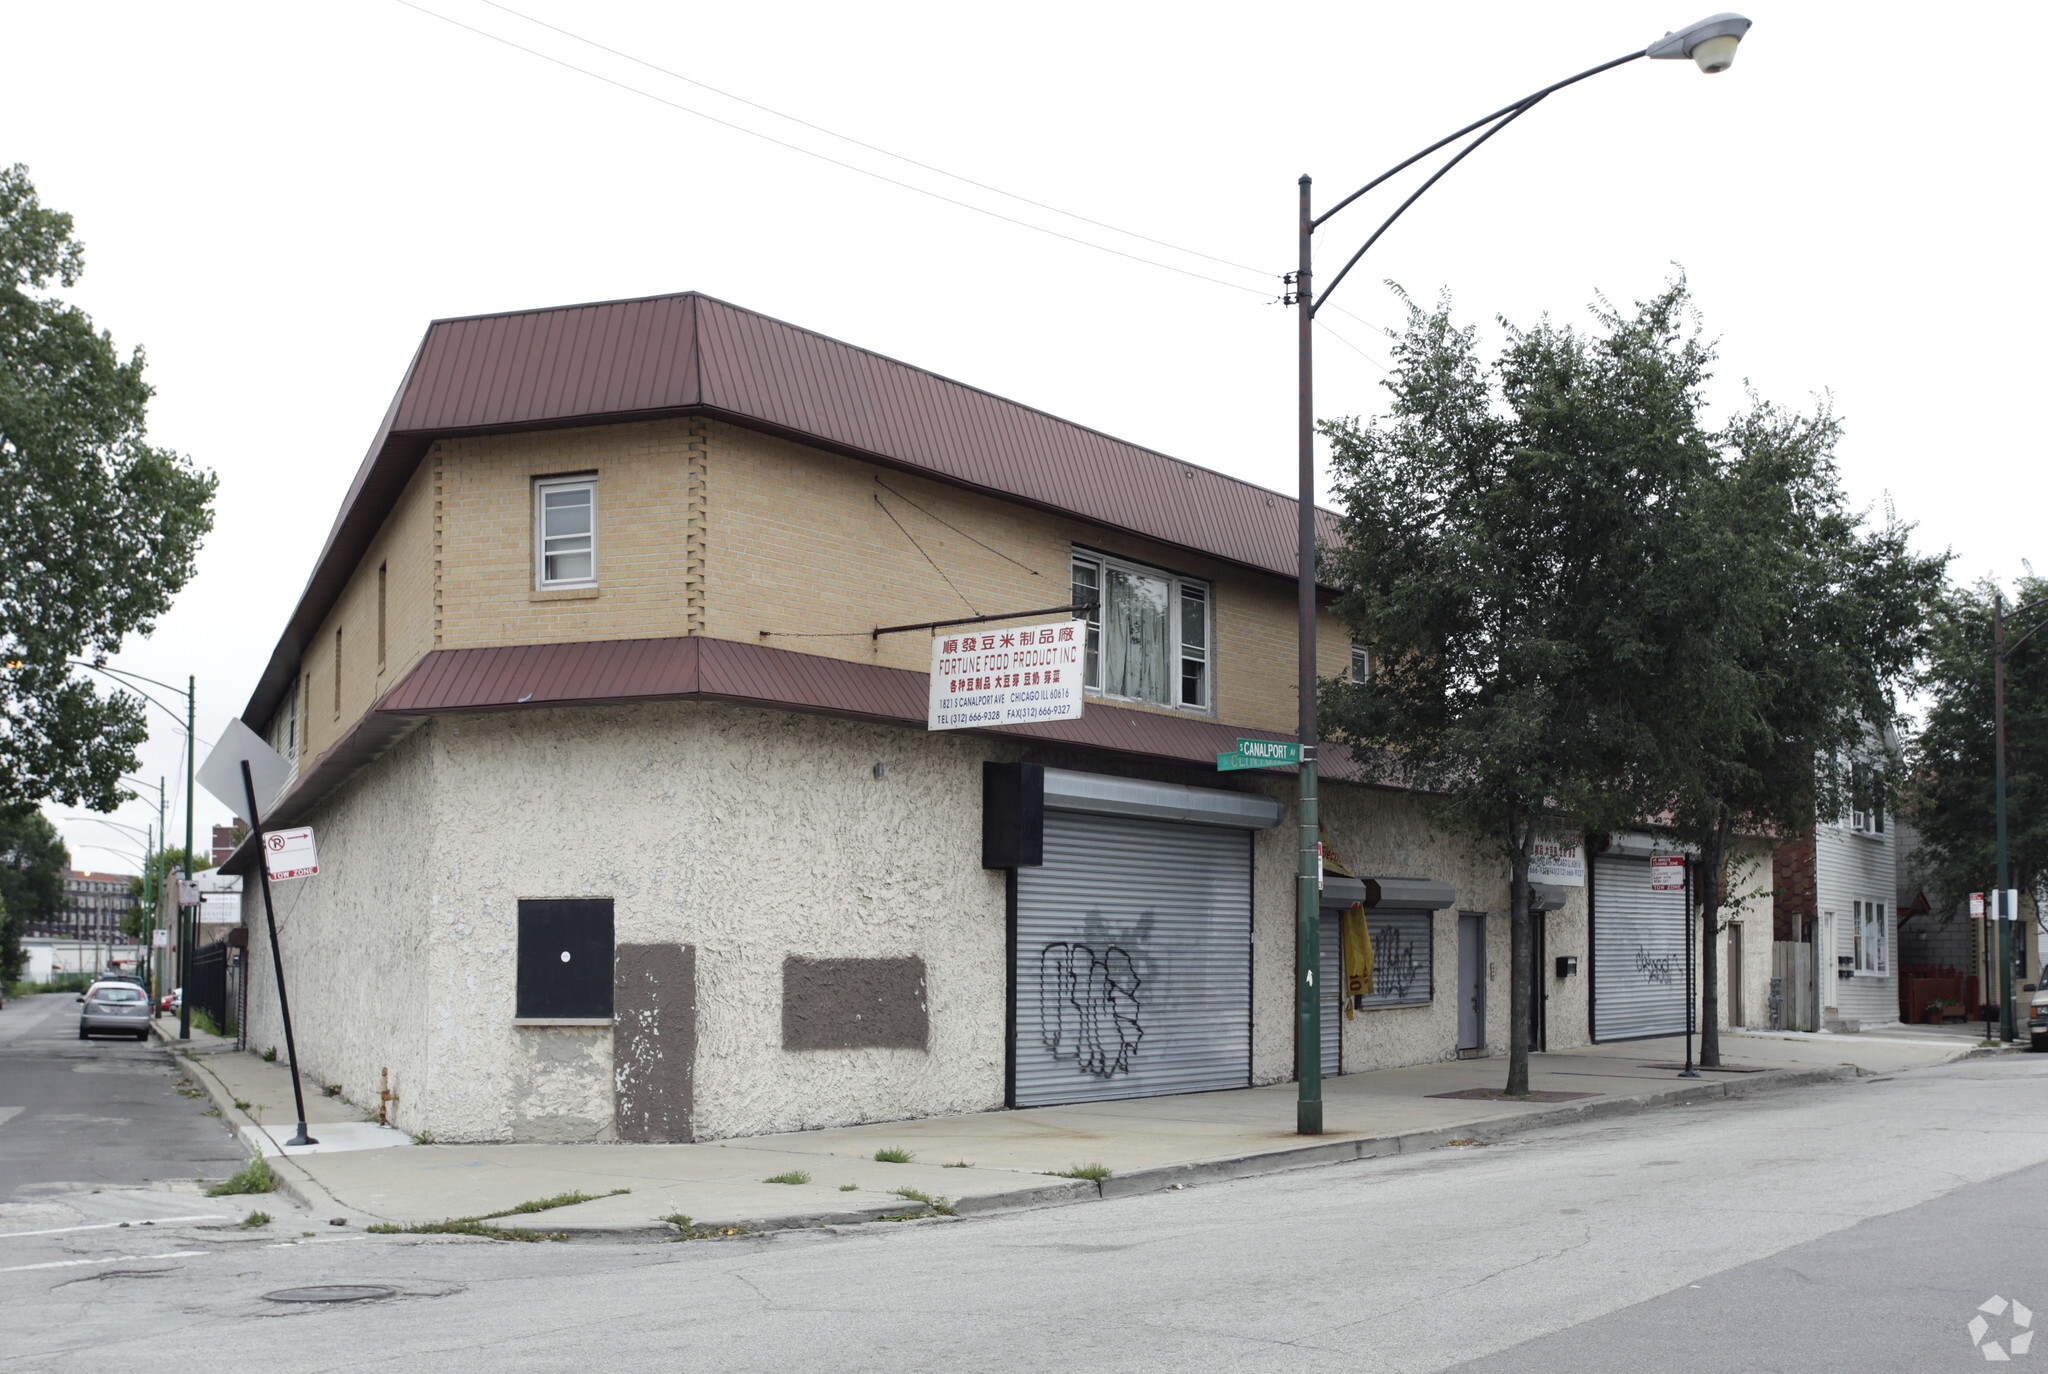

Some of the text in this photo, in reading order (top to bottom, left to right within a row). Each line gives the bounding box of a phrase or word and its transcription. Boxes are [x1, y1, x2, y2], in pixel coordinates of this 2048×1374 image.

[943, 626, 1074, 654] 順發豆米制品廠
[939, 646, 1077, 675] FORTUNE FOOD PRODUCT INC
[939, 688, 1069, 709] 1821 S CANALPORT AVE CHICAGO ILL 60616
[937, 715, 949, 725] TEL
[950, 713, 967, 725] (312)
[968, 710, 1001, 722] 666-9328
[1039, 704, 1071, 716] 666-9327
[1240, 743, 1244, 752] S
[1243, 741, 1288, 759] CANALPORT
[273, 866, 314, 880] TOW ZONE
